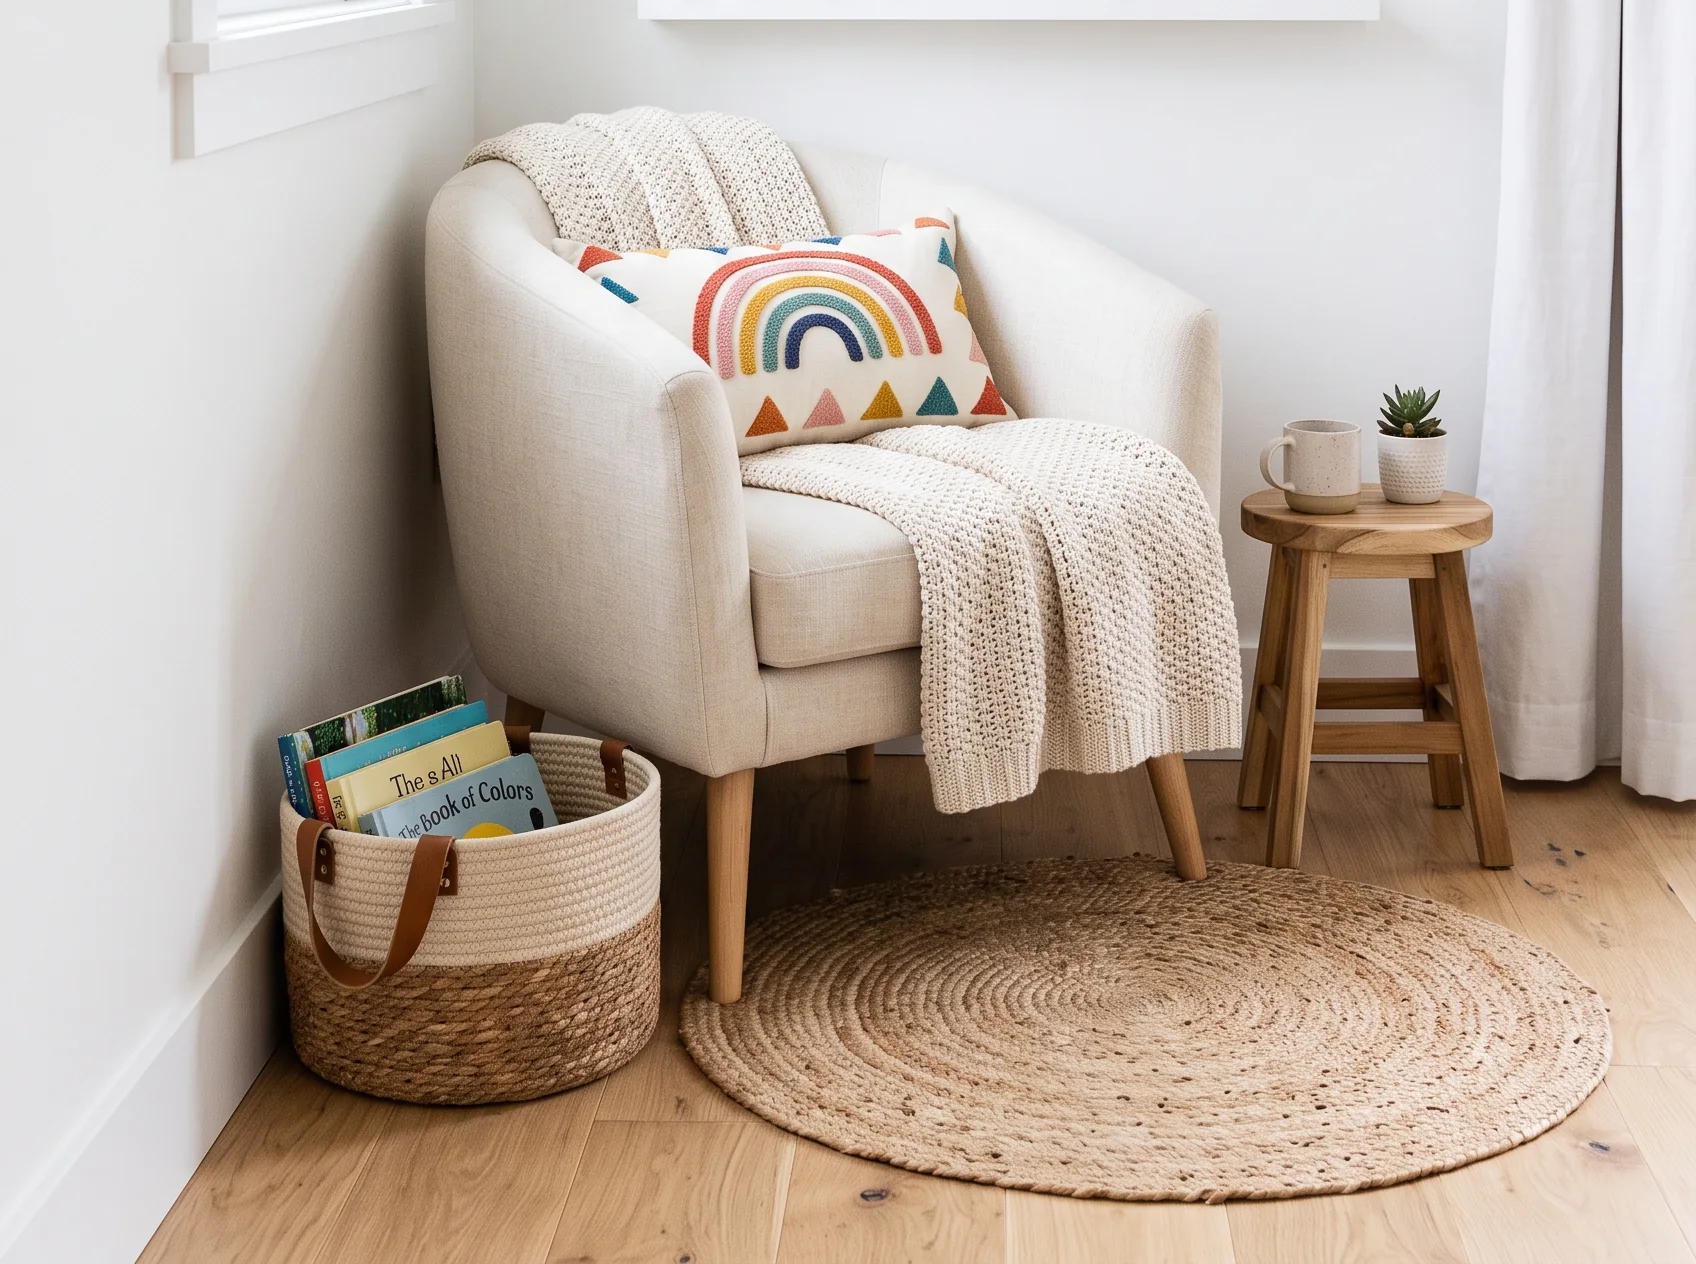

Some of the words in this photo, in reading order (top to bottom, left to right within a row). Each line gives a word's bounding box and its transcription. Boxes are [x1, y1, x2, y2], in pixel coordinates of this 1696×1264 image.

[390, 773, 425, 798] The
[428, 770, 439, 785] s
[441, 753, 463, 780] All
[419, 794, 461, 833] Book
[461, 785, 476, 810] of
[478, 777, 534, 803] Colors
